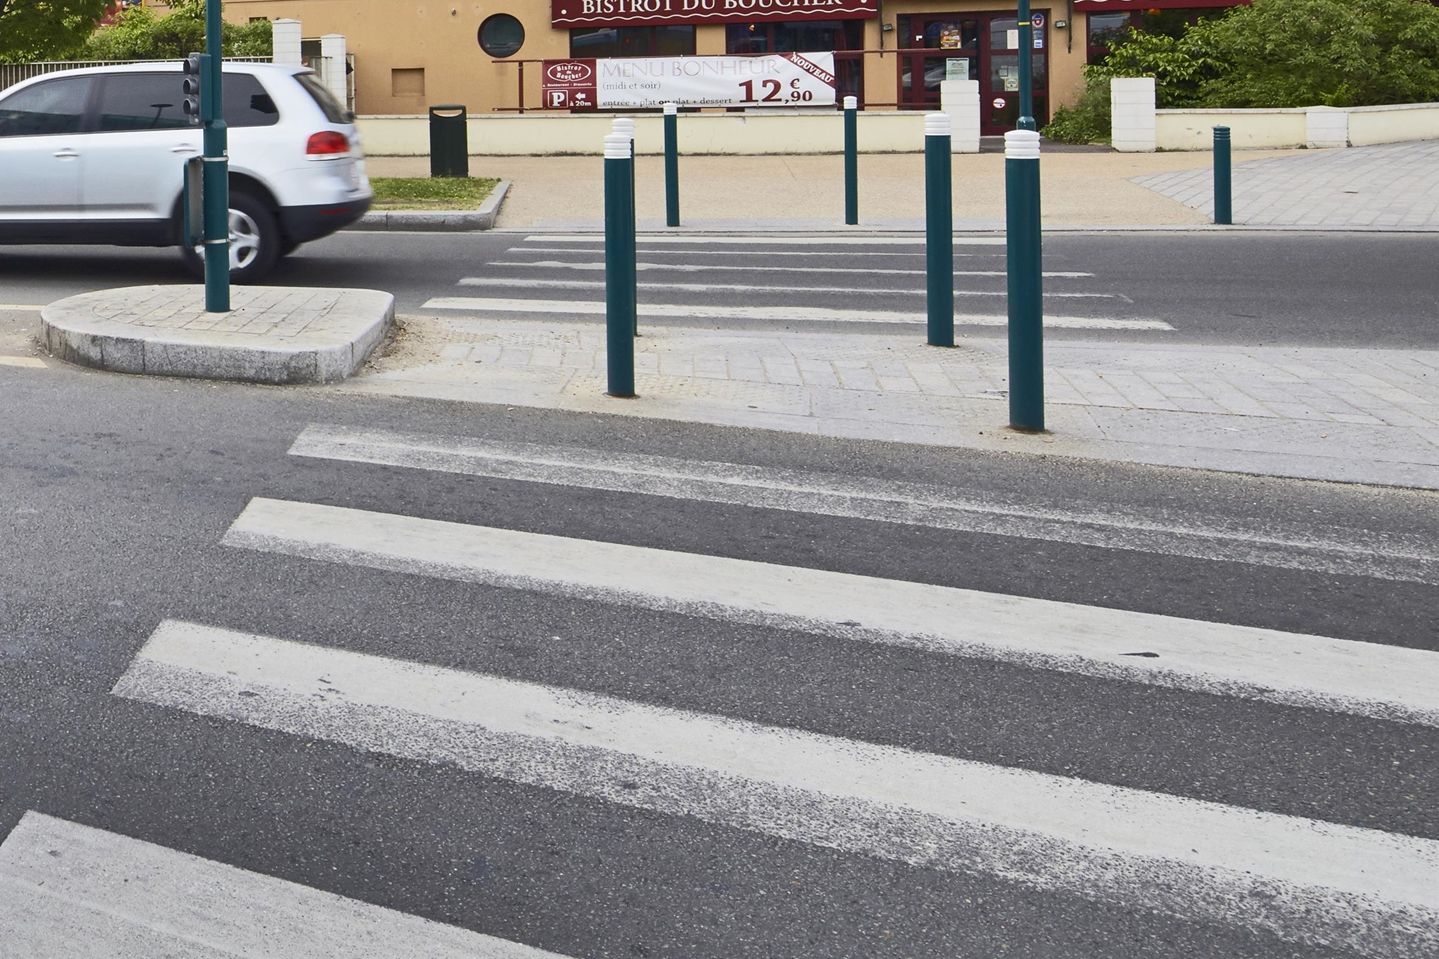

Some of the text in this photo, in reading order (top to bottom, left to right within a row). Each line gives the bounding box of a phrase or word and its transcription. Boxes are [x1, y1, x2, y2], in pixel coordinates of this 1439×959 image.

[602, 57, 781, 78] MENU BONHEUR
[790, 55, 835, 83] NOUVEAU
[552, 92, 565, 106] P
[639, 97, 656, 108] plat
[700, 97, 732, 105] dessert
